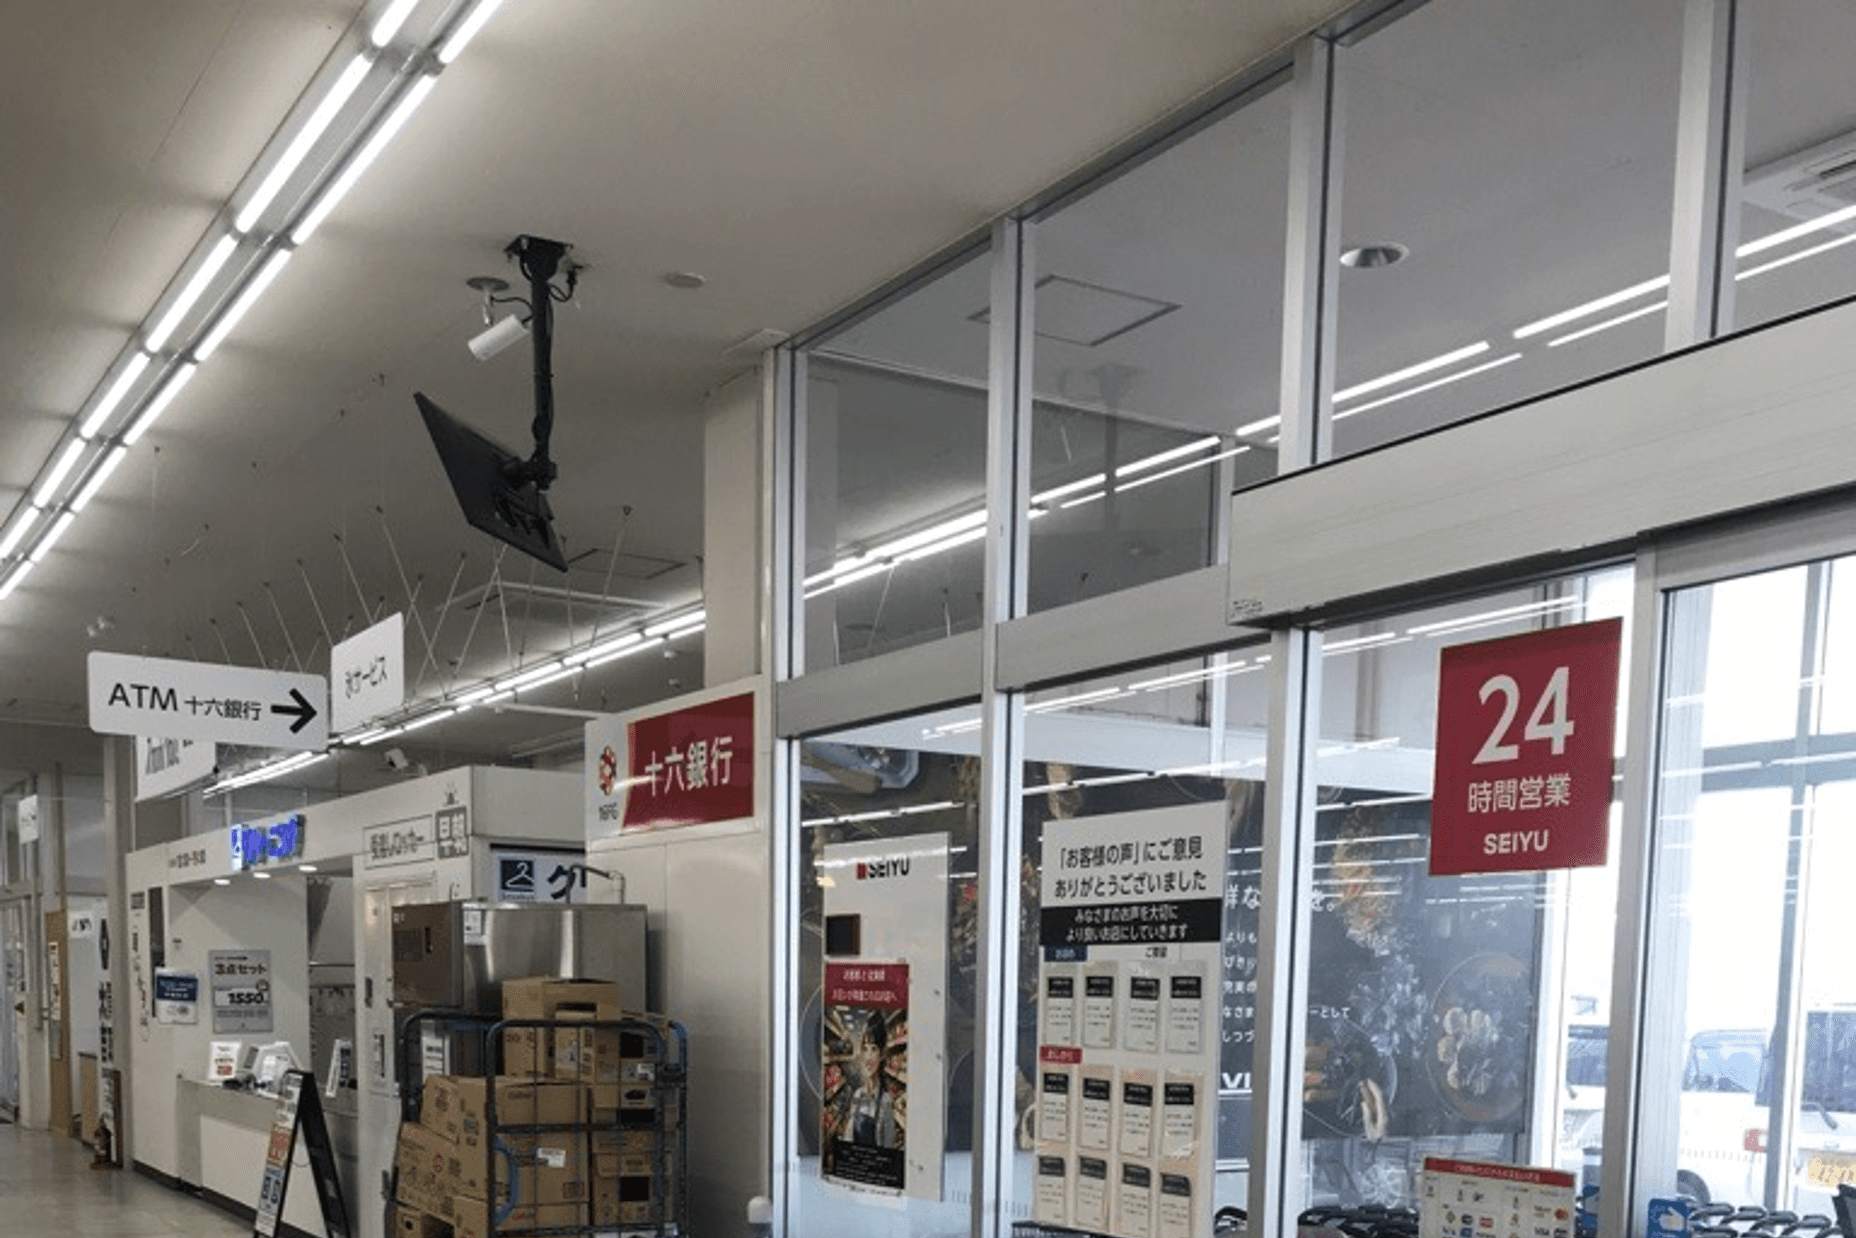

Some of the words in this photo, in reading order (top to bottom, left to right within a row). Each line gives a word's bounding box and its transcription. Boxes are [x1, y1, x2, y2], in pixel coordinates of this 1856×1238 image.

[108, 683, 179, 712] ATM
[184, 696, 262, 721] 十六銀行
[1471, 665, 1576, 765] 24
[644, 736, 734, 798] 十六銀行
[1467, 772, 1572, 814] 時間営業
[1061, 835, 1203, 871] 「お客様の声」にご意見
[1483, 828, 1550, 856] SEIYU
[868, 857, 911, 879] SEIYU
[1054, 869, 1207, 899] ありがとうございました
